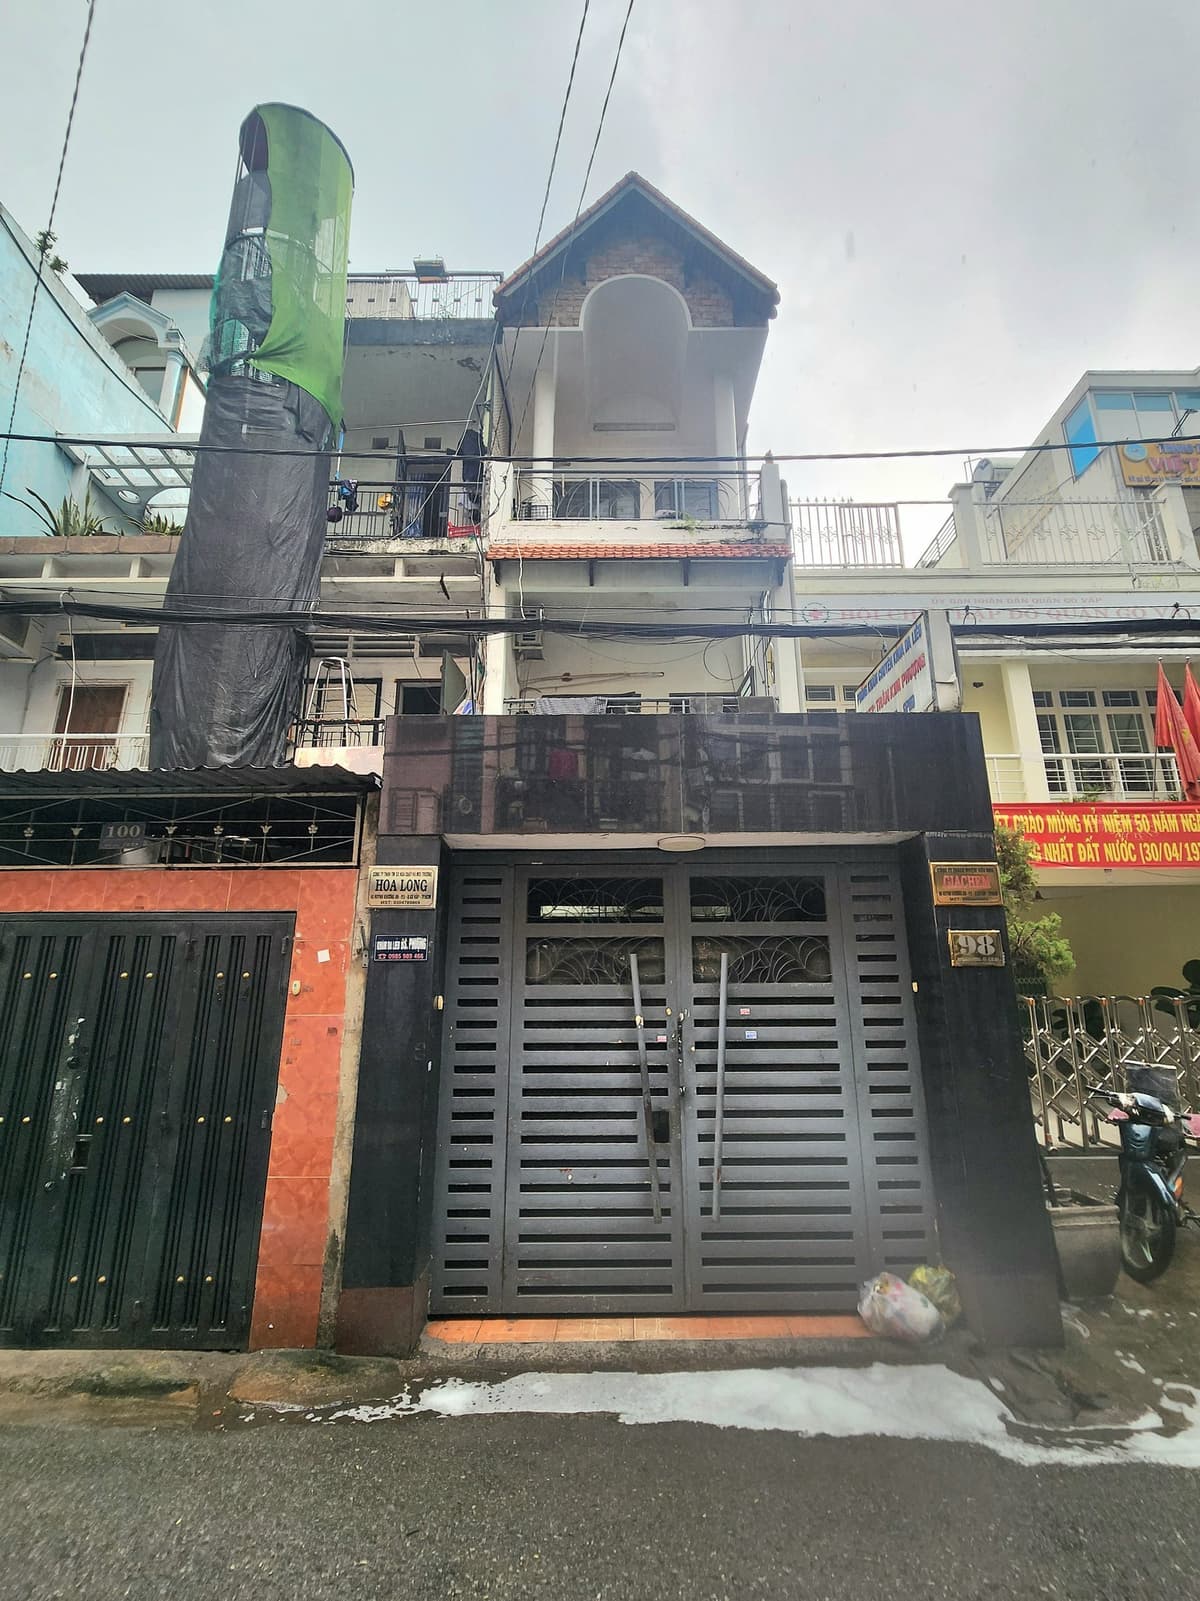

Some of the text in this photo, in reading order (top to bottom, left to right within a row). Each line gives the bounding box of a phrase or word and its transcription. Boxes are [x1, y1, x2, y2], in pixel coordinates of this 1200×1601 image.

[1046, 809, 1082, 833] MỪNG
[1082, 807, 1099, 833] KỶ
[1102, 809, 1133, 833] NIỆM
[1134, 814, 1151, 833] 50
[1151, 810, 1179, 832] NĂM
[105, 825, 140, 838] 100
[1043, 835, 1074, 862] NHẤT
[1077, 835, 1101, 862] ĐẤT
[1103, 837, 1137, 862] NƯỚC
[1139, 842, 1200, 864] (30/04/19
[375, 879, 428, 892] HOA LONG
[958, 935, 996, 956] 98
